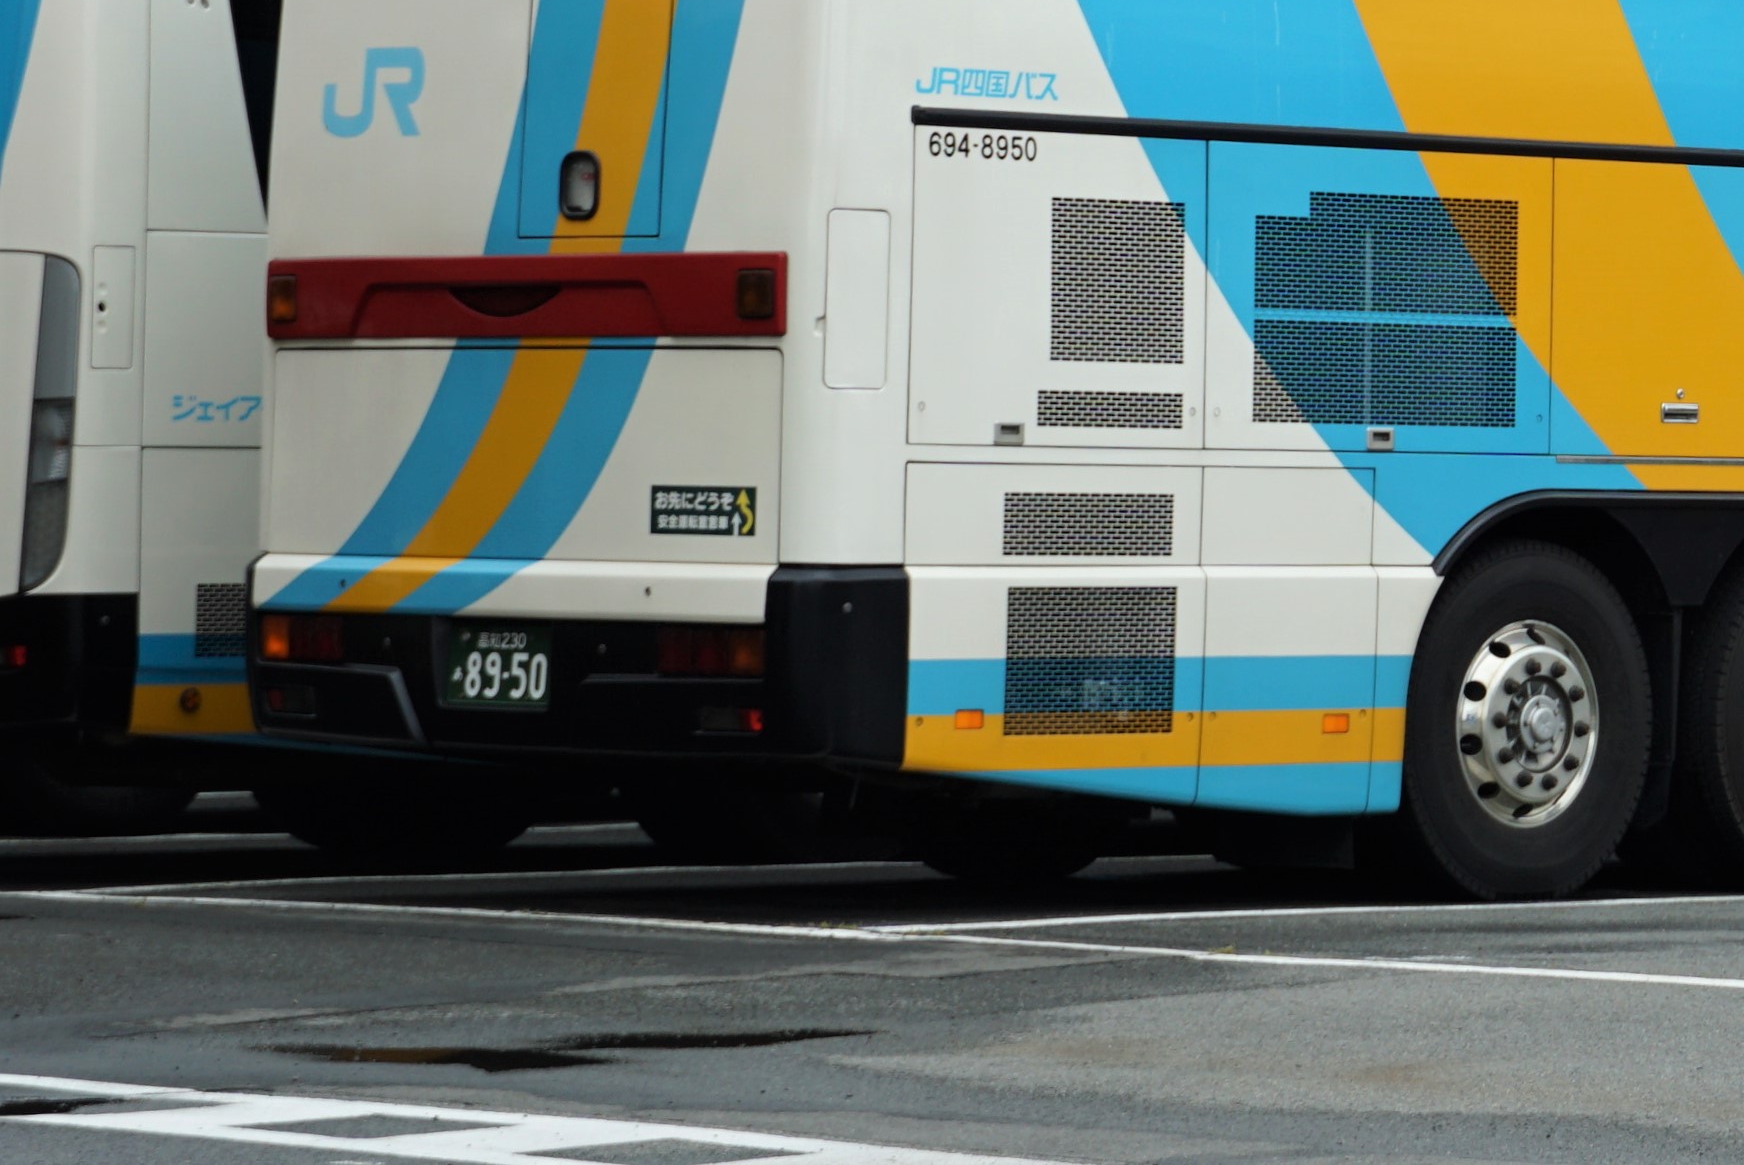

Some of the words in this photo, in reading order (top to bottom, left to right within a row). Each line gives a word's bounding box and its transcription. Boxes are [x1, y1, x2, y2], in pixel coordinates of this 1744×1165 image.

[323, 46, 426, 138] JR
[915, 66, 1058, 101] JR四国バス
[929, 131, 1037, 162] 694-8950
[655, 491, 734, 511] お先にどうぞ
[464, 651, 548, 700] 89-50
